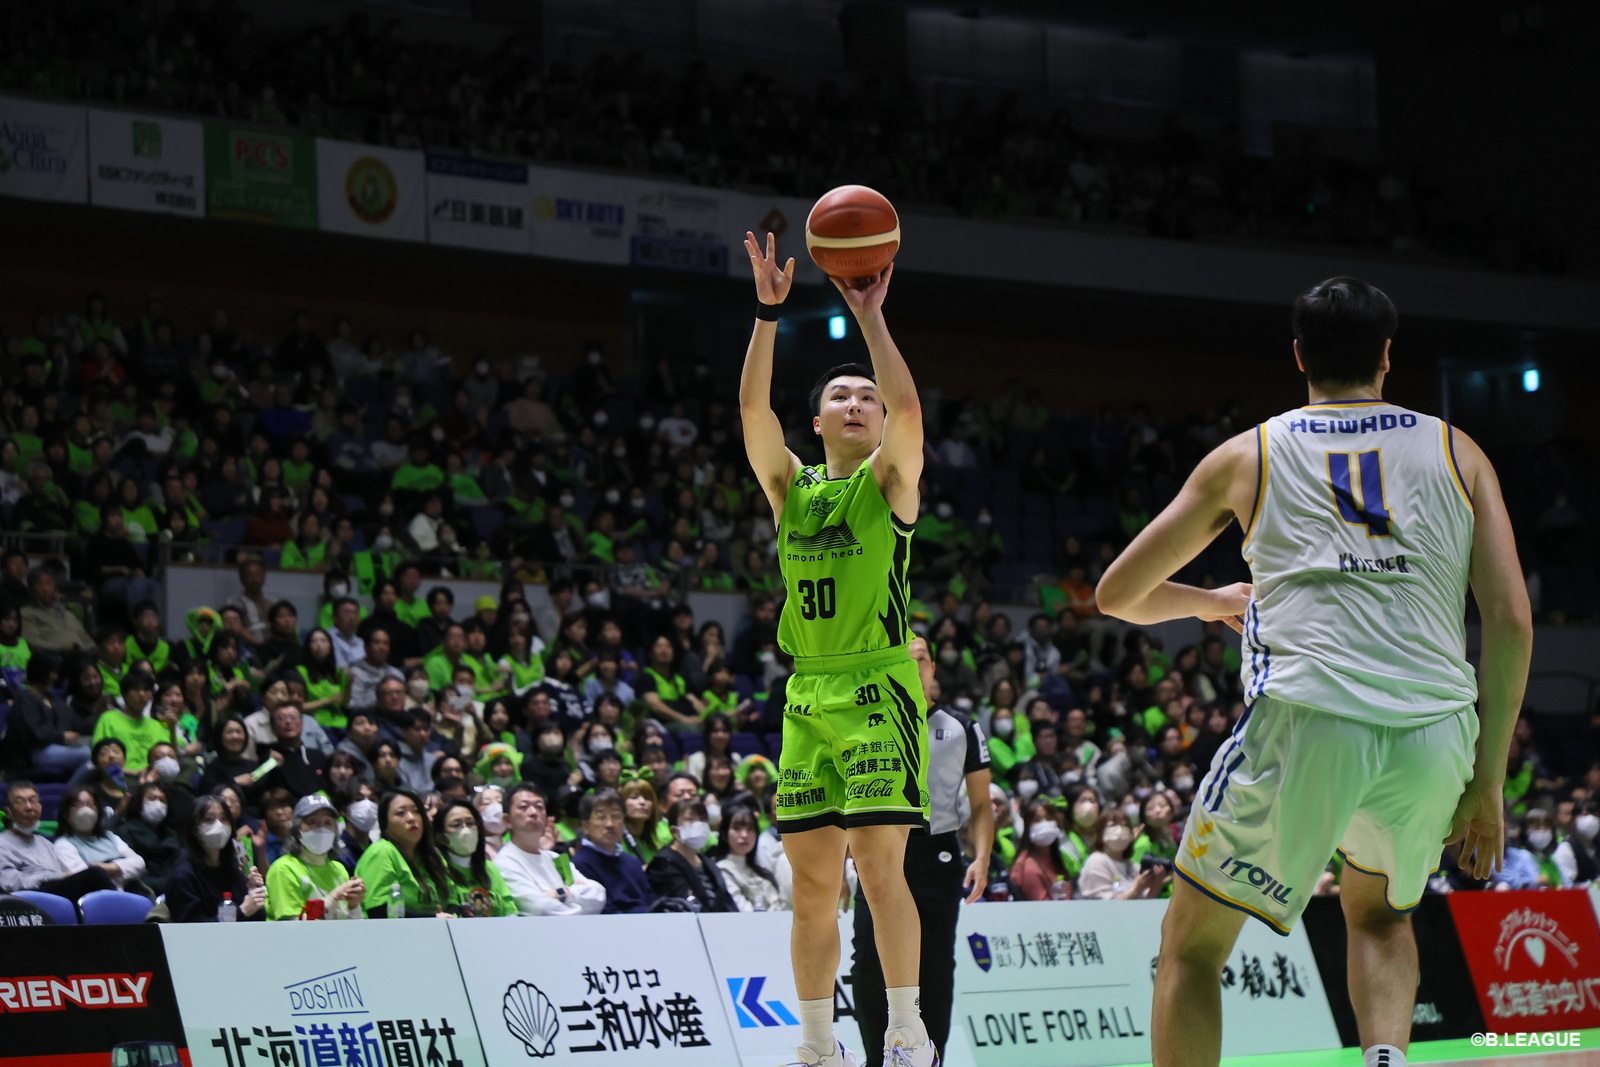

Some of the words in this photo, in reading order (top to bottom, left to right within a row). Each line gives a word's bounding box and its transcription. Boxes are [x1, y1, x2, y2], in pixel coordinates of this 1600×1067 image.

[235, 138, 289, 170] PCS
[1290, 413, 1418, 434] HEIWADO
[1325, 447, 1394, 539] 4
[831, 546, 863, 560] head
[797, 577, 836, 621] 30
[854, 683, 881, 707] 30
[846, 778, 896, 801] Coca-Cola
[1013, 931, 1104, 969] 大藤学園
[289, 973, 365, 1012] DOSHIN
[581, 966, 662, 995] 丸ウロコ
[560, 993, 712, 1053] 三和水産
[968, 1012, 1038, 1047] LOVE
[1042, 1009, 1092, 1043] FOR
[1099, 1005, 1144, 1040] ALL
[211, 1018, 464, 1067] 北海道新聞社
